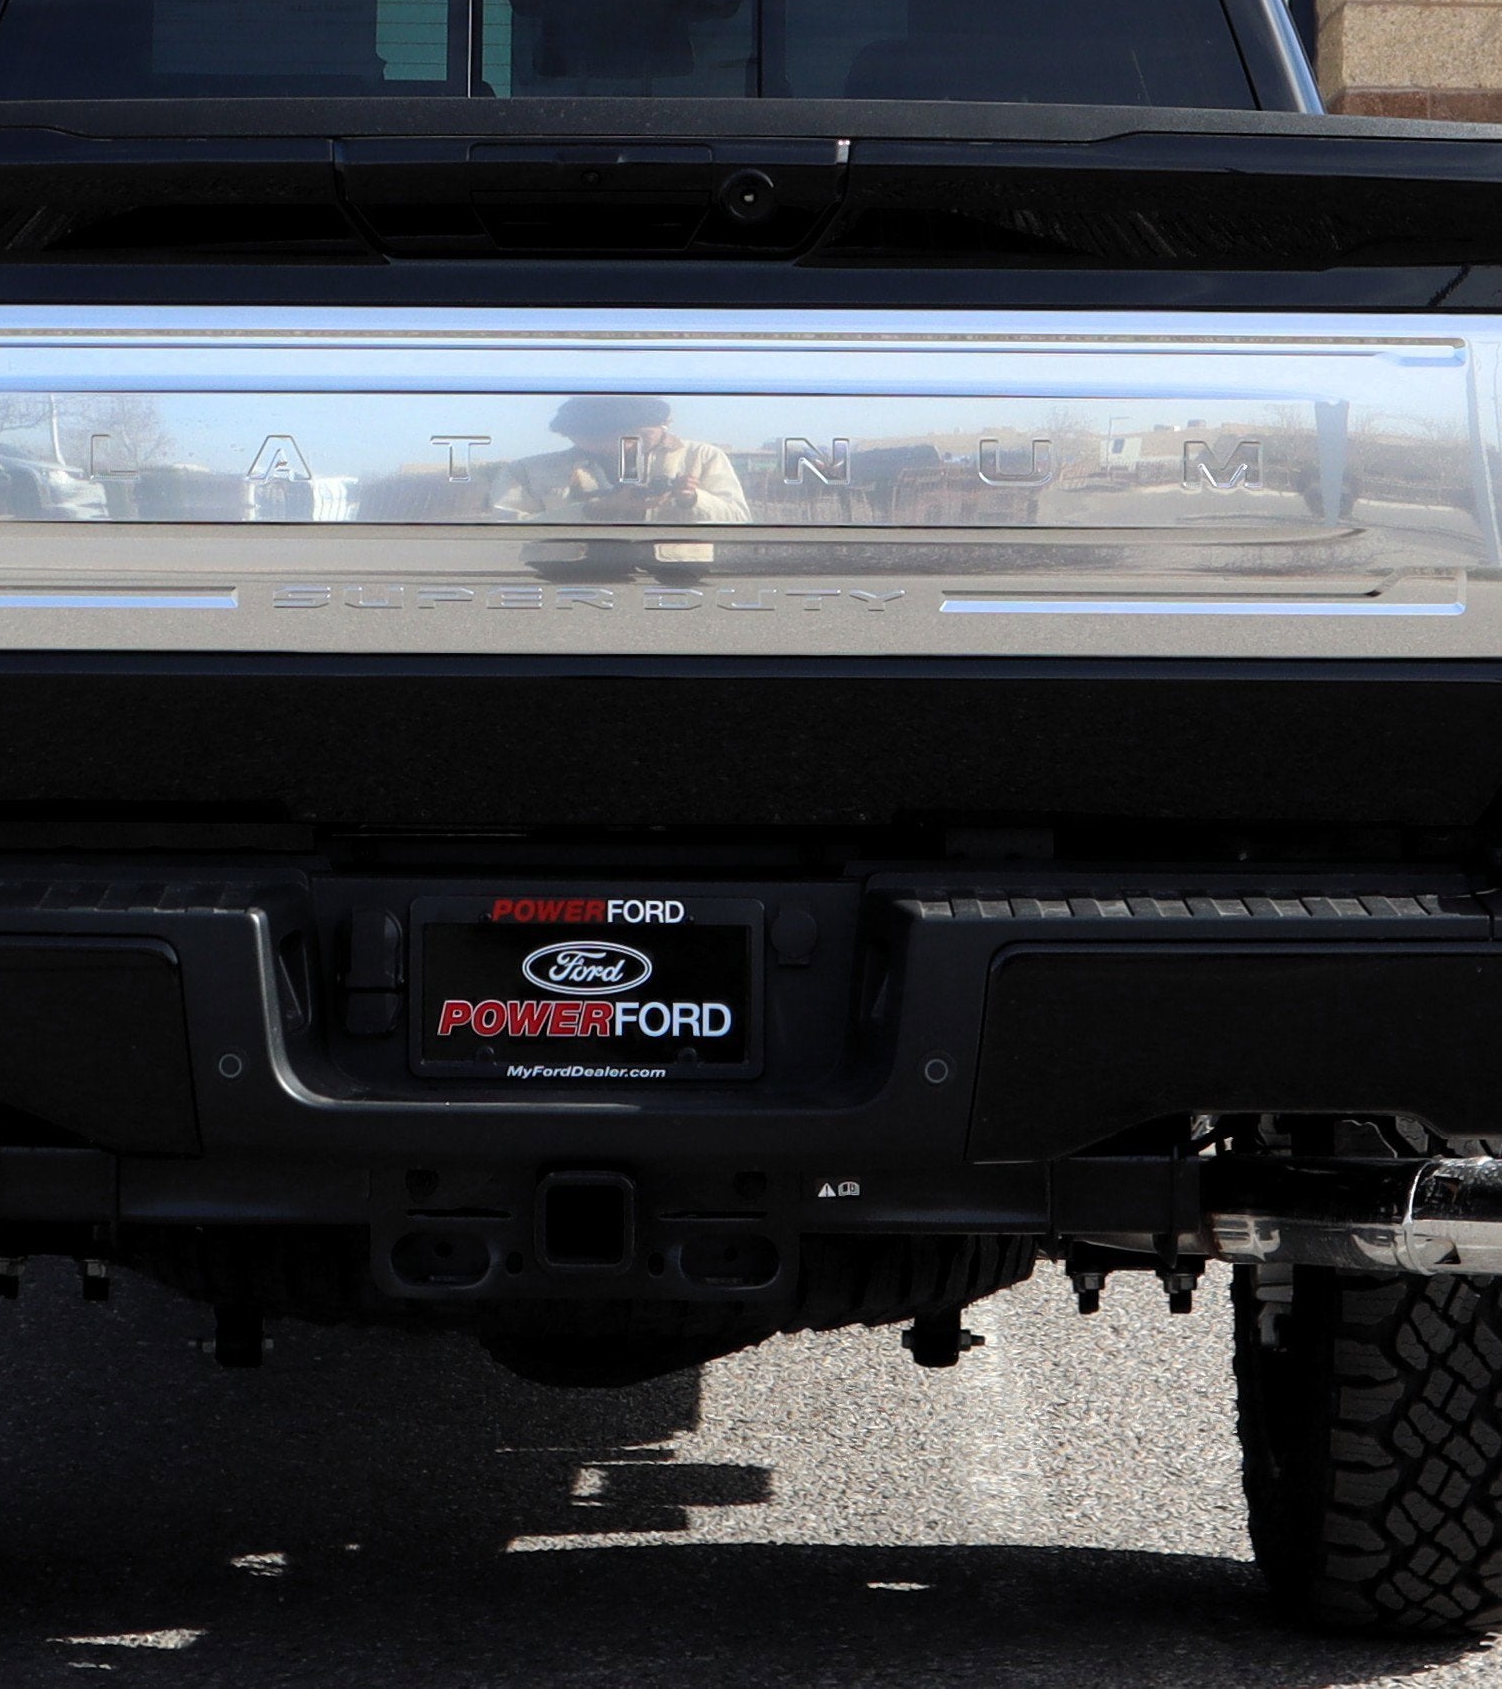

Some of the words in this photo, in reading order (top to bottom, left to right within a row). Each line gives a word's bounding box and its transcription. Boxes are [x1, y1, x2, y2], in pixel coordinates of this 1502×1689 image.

[272, 585, 614, 610] SUPER
[643, 586, 905, 612] DUTY
[491, 899, 685, 924] POWERFORD
[548, 950, 626, 983] Ford
[437, 999, 732, 1037] POWERFORD
[506, 1065, 667, 1079] MyFordDealer.com
